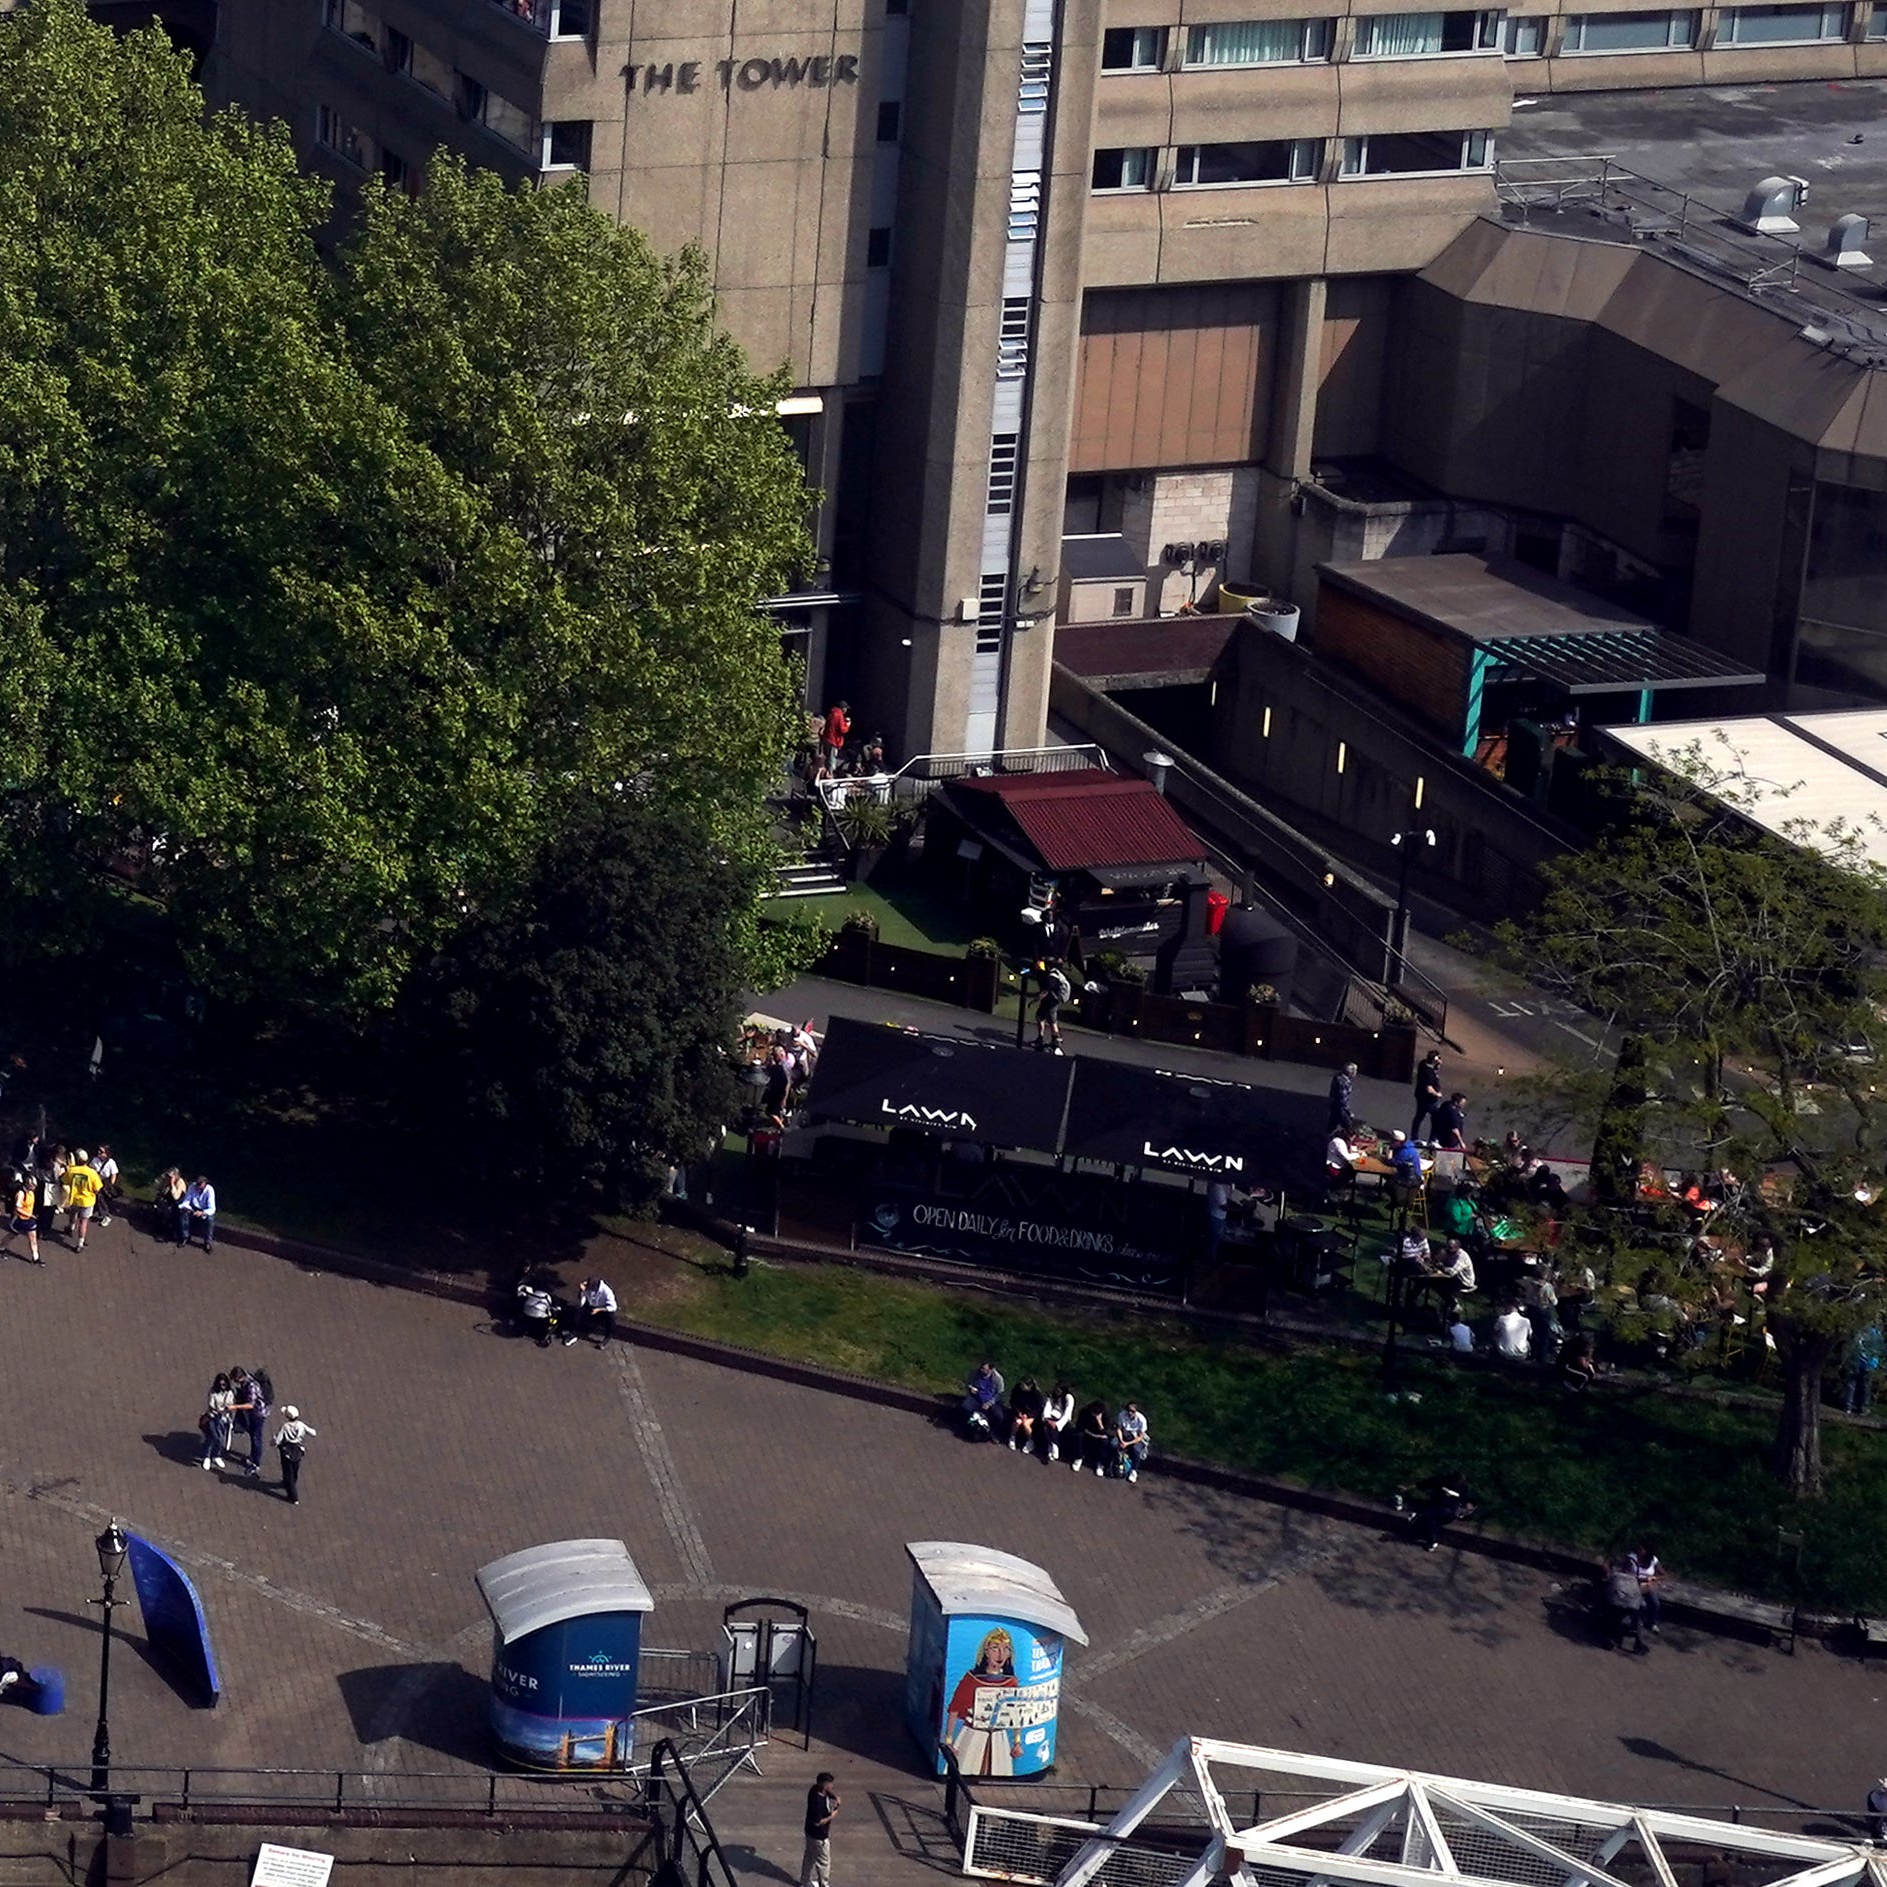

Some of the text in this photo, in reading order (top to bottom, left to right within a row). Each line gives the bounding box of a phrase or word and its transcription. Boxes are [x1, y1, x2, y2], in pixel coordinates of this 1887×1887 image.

[618, 54, 859, 98] THE TOWER
[881, 1098, 977, 1131] LAWN
[1143, 1141, 1243, 1171] LAWN
[913, 1204, 956, 1230] OPEN
[958, 1210, 998, 1235] DAILY
